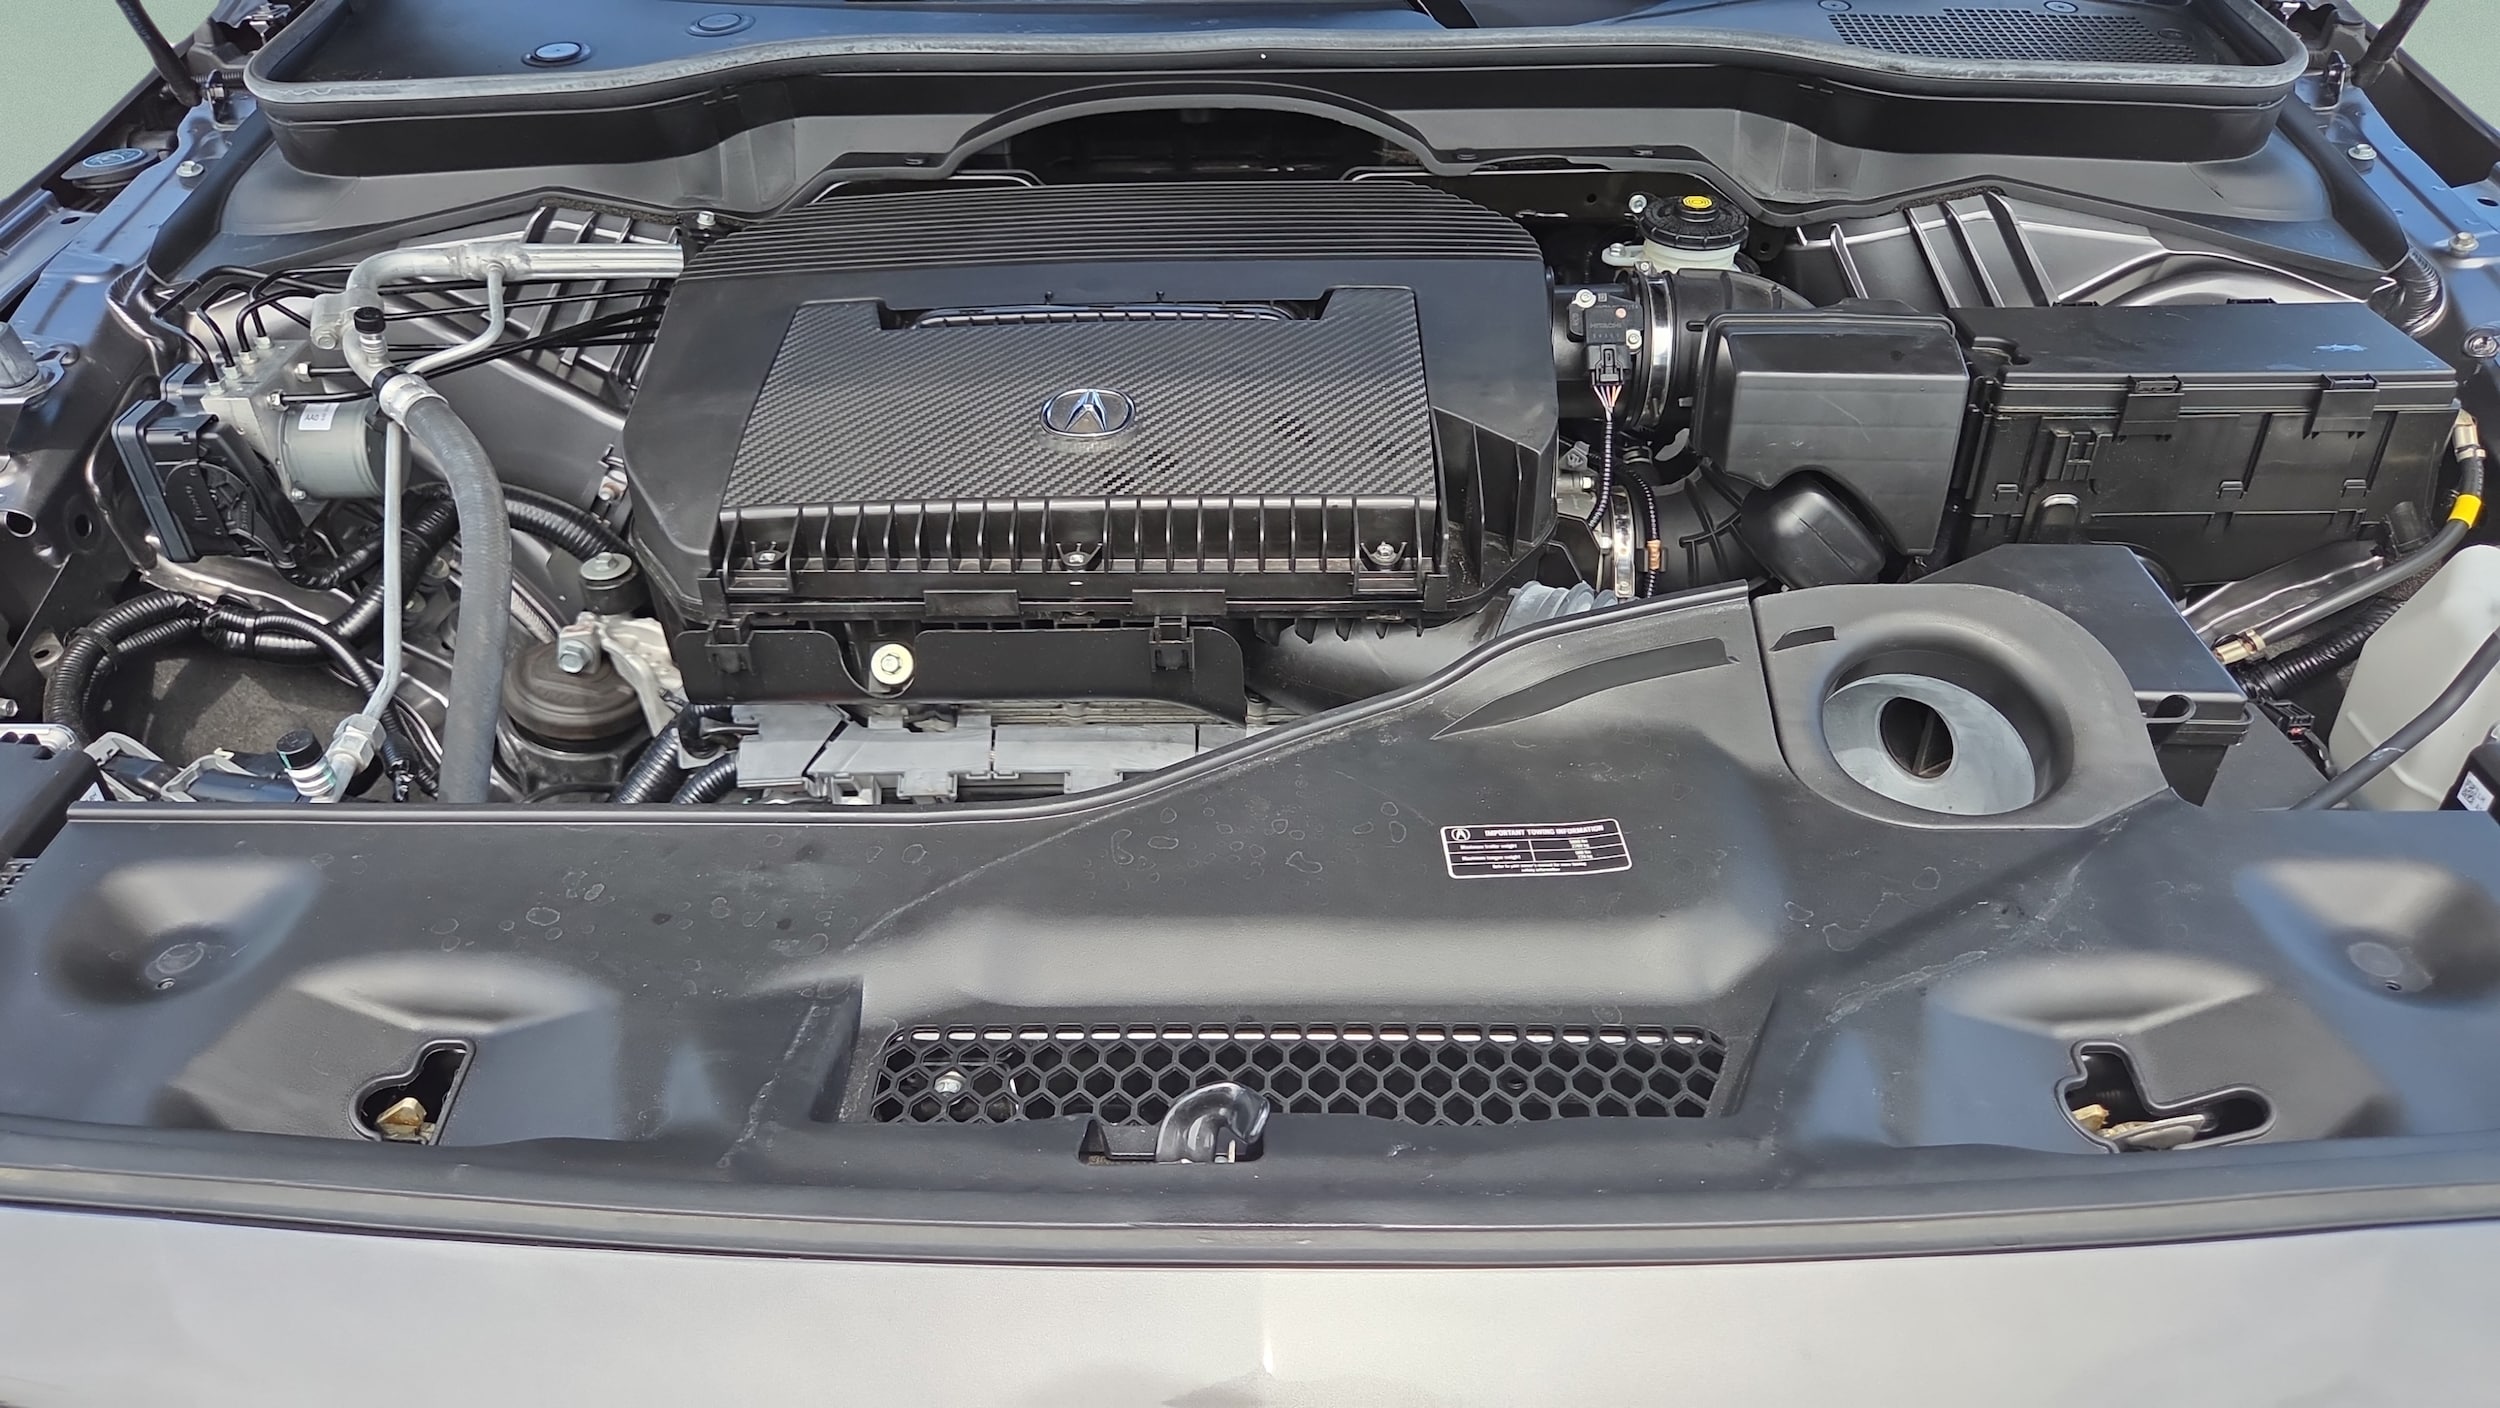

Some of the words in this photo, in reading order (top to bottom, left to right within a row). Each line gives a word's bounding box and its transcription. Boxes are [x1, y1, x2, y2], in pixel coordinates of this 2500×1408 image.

[1484, 829, 1525, 837] IMPORTANT
[1526, 828, 1555, 836] TOWING
[1555, 825, 1604, 835] INFORMATION
